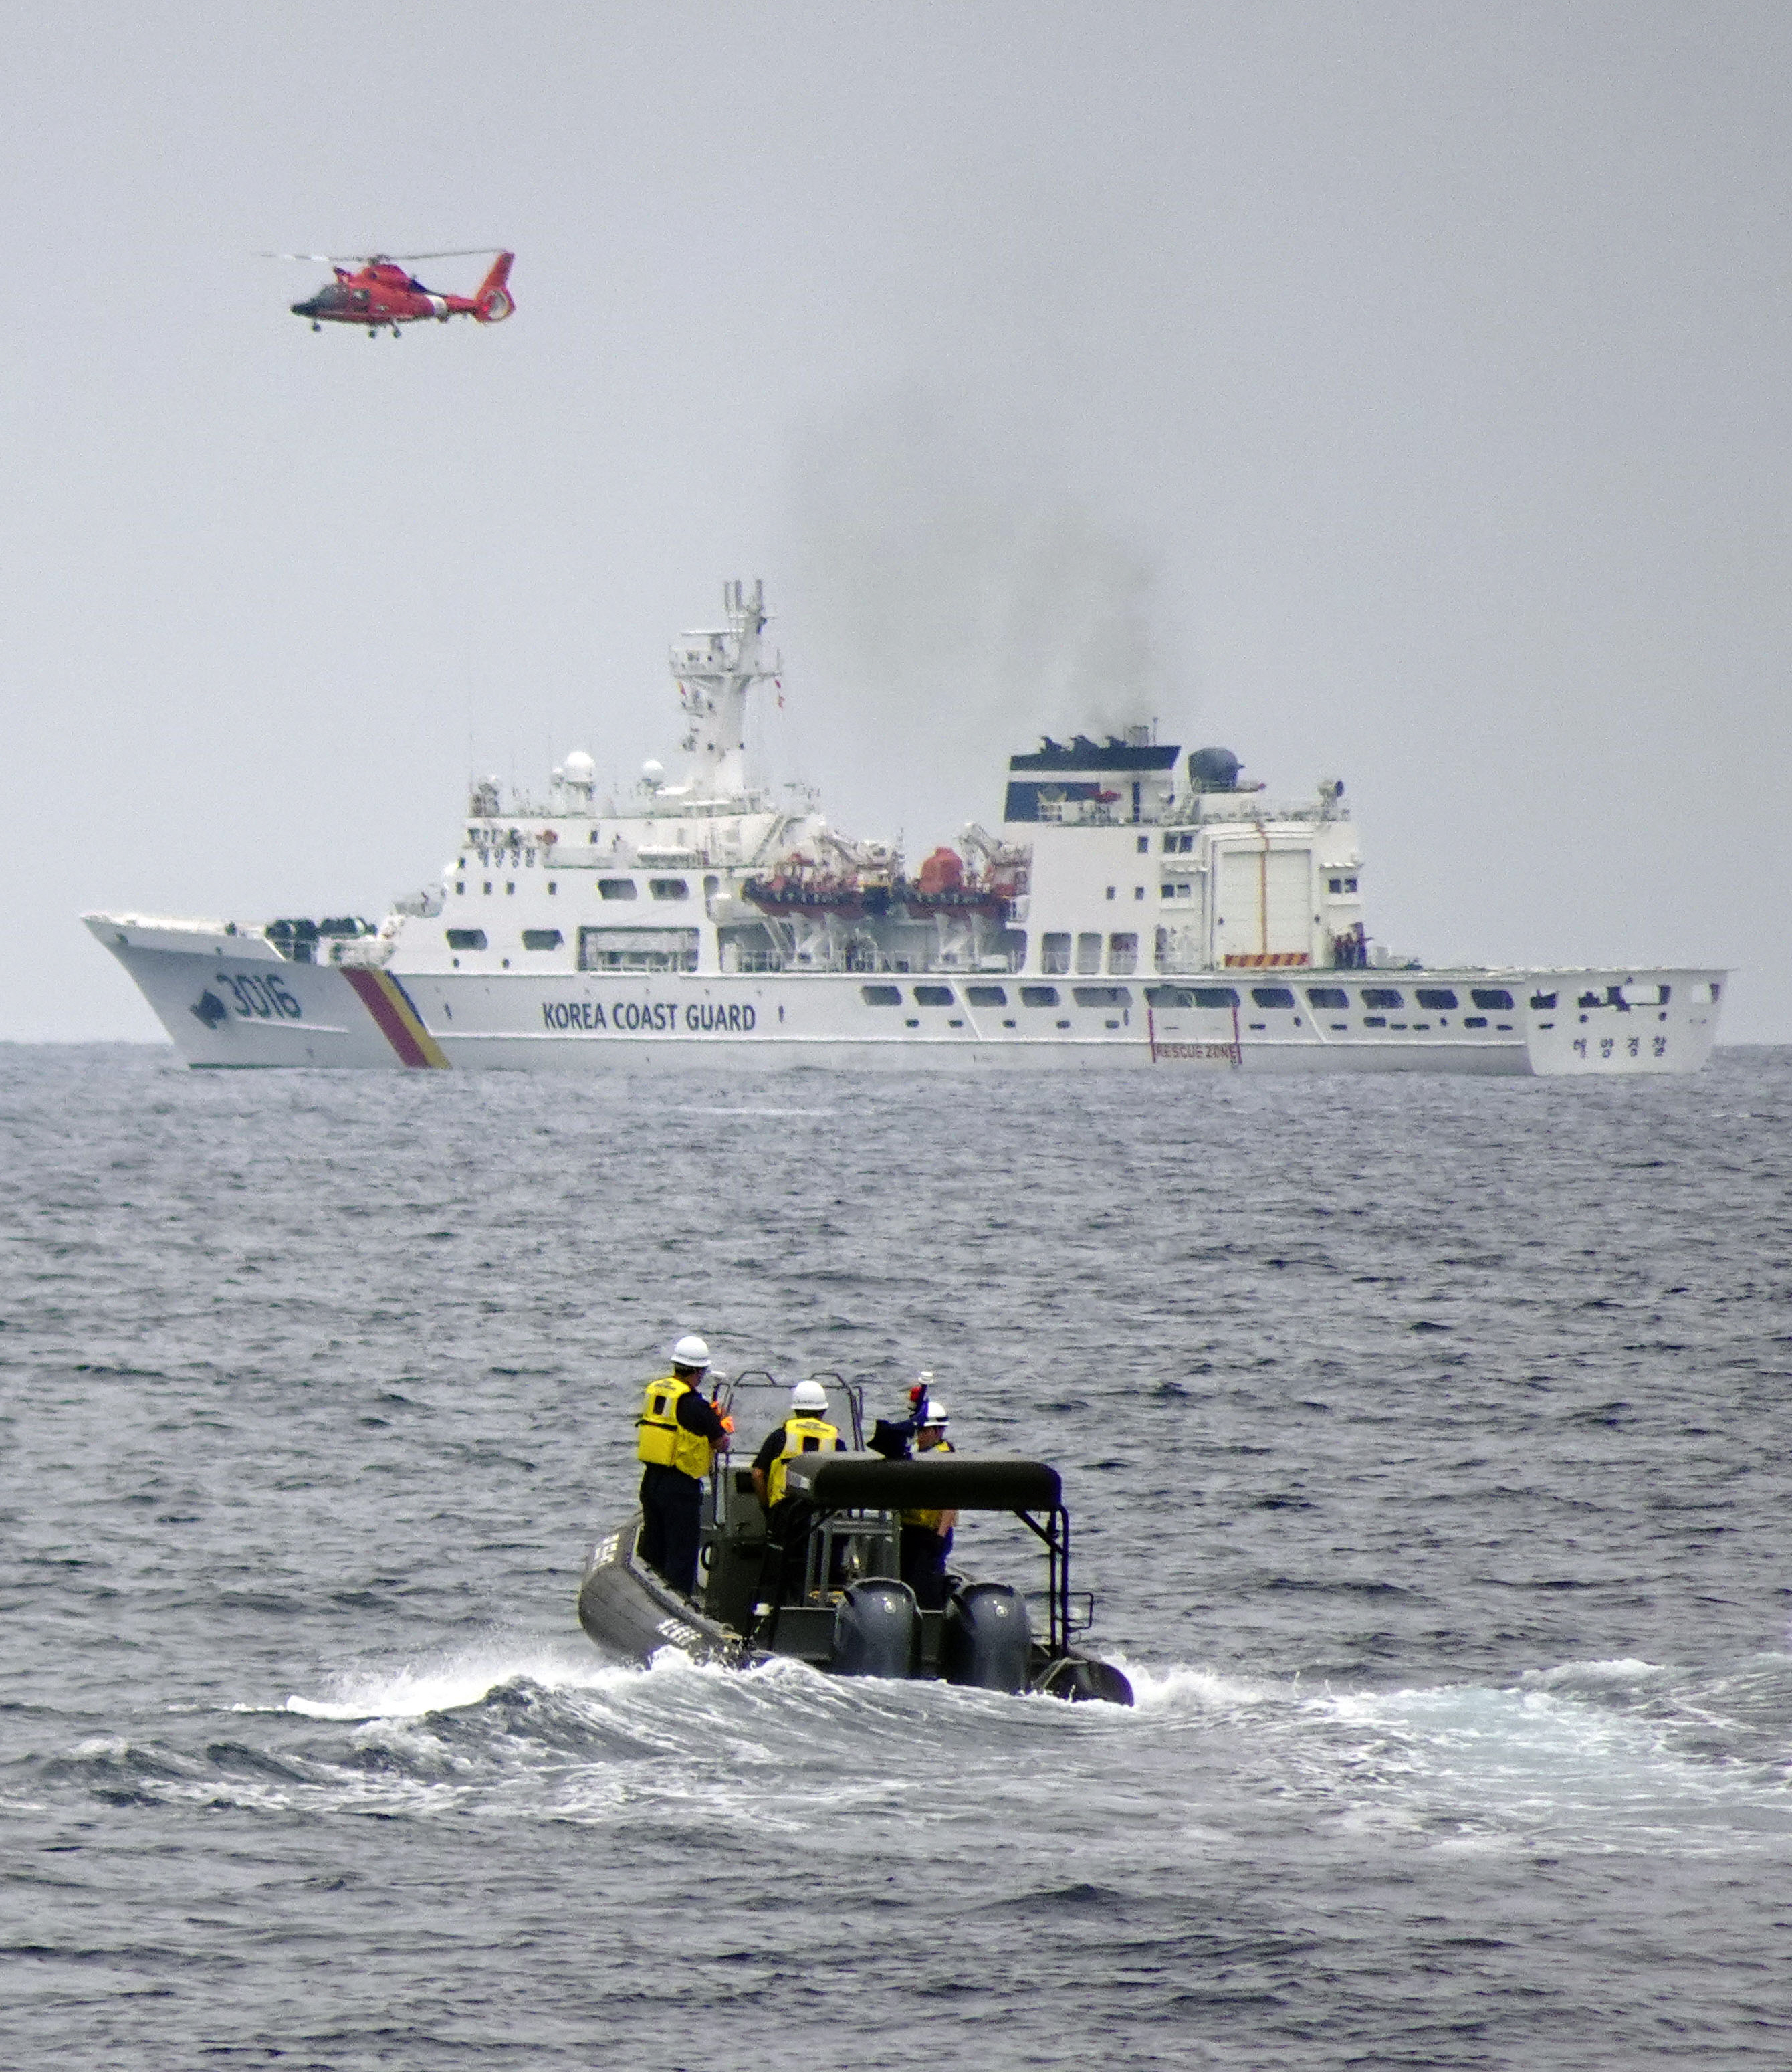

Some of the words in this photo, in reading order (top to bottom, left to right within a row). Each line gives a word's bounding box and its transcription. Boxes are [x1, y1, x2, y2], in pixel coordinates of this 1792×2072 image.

[216, 973, 302, 1019] 3016
[542, 1002, 606, 1029] KOREA
[613, 1003, 678, 1030] COAST
[686, 1004, 756, 1031] GUARD
[1154, 1045, 1203, 1058] RESCUE
[1206, 1045, 1237, 1059] ZONE
